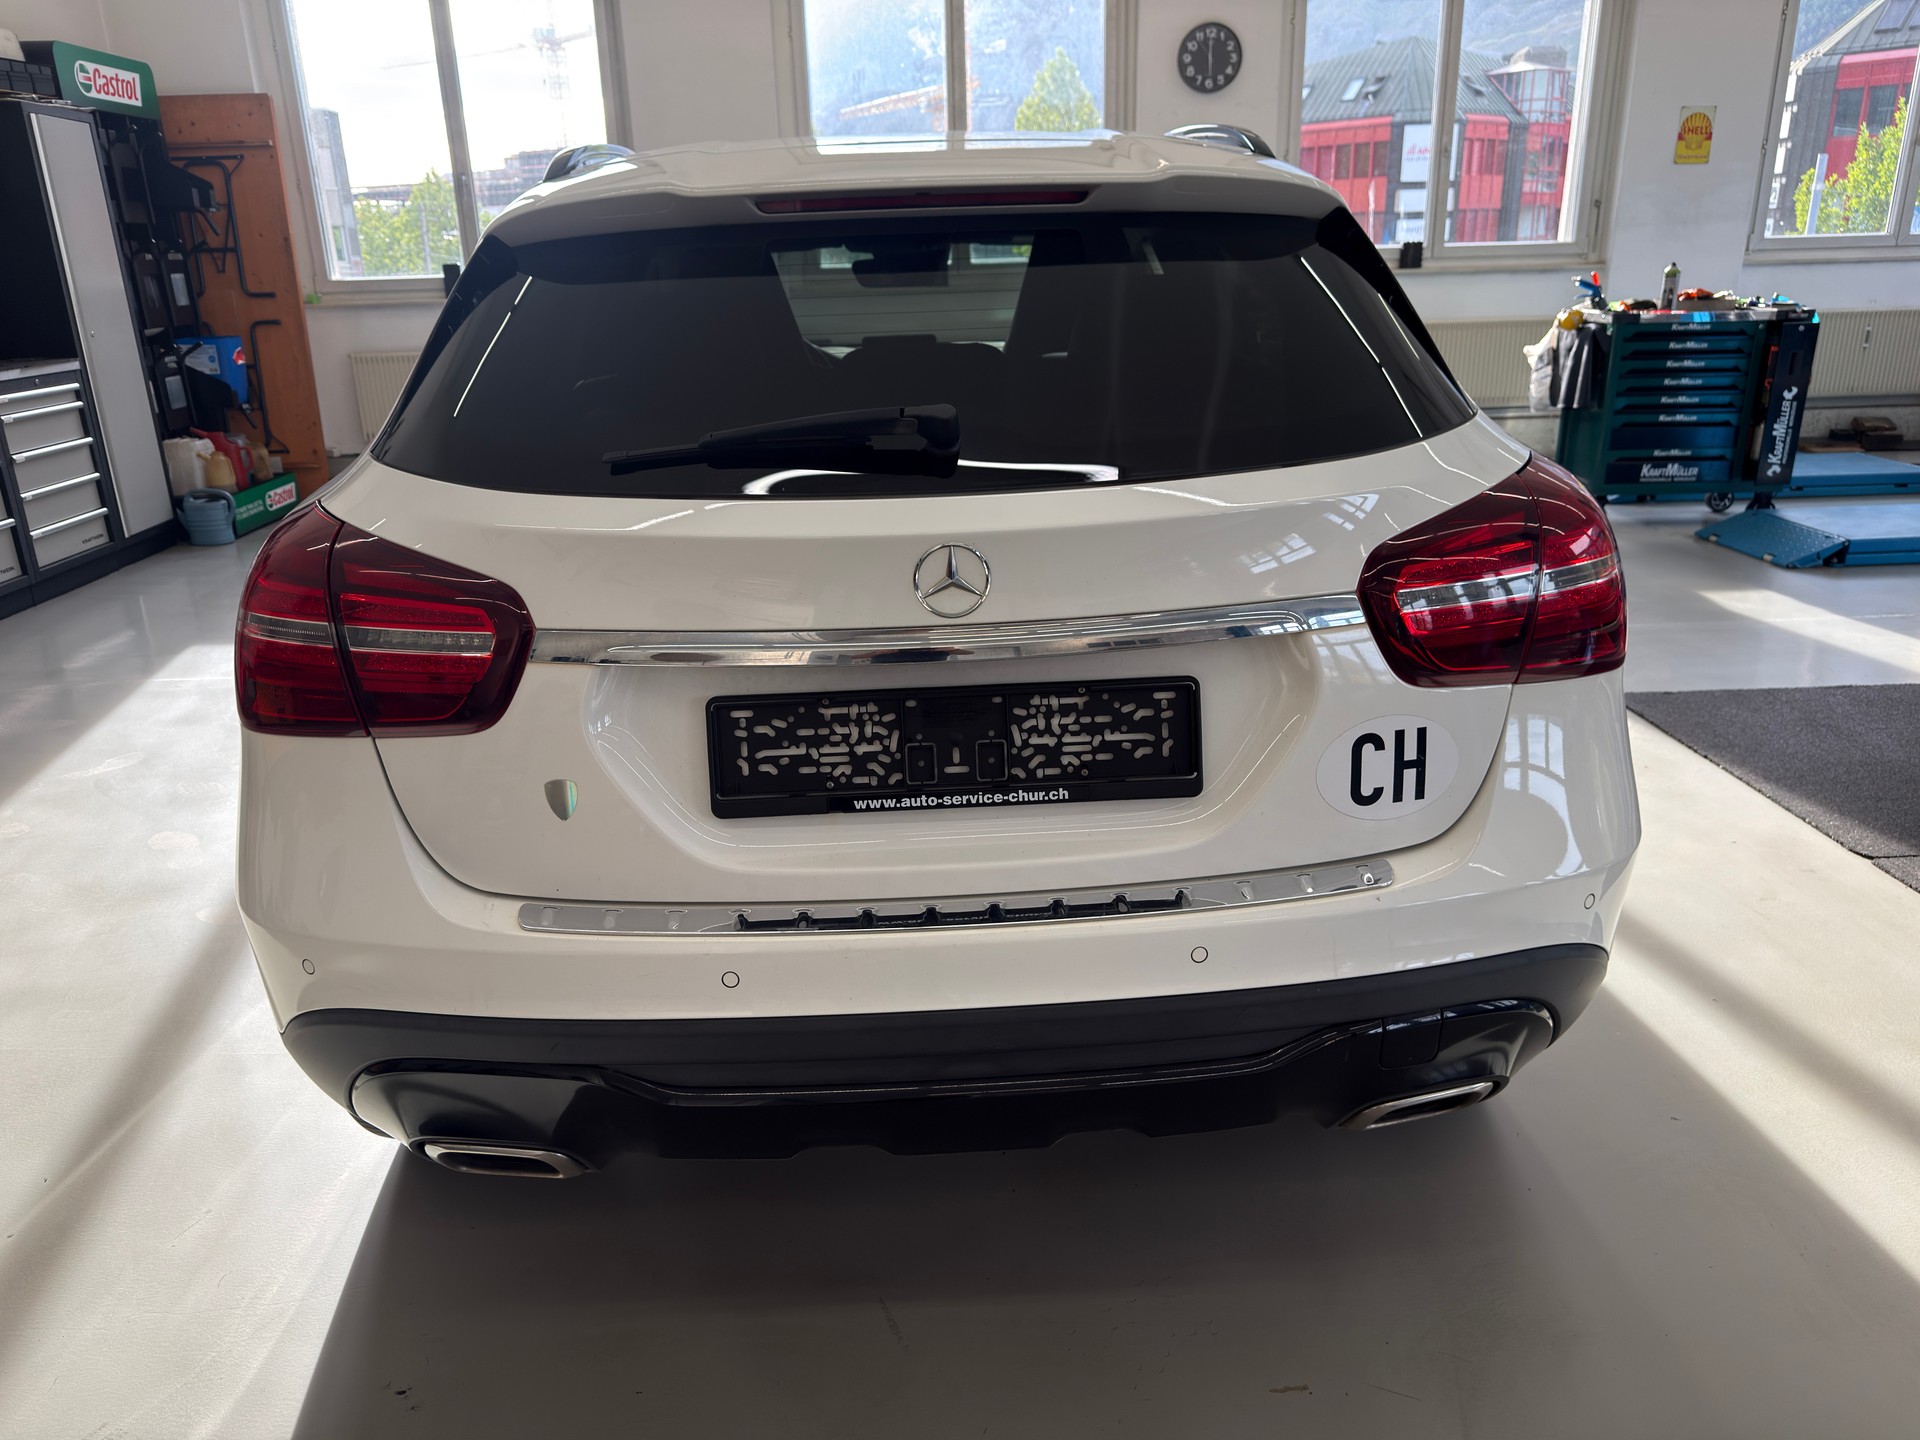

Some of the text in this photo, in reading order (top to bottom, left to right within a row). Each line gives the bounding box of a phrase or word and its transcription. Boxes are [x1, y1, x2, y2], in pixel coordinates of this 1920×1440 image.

[1196, 31, 1204, 41] 11
[1206, 27, 1217, 38] 12
[1220, 31, 1225, 41] 1
[1187, 40, 1198, 52] 10
[1226, 40, 1234, 51] 2
[1182, 53, 1192, 64] 9
[1229, 52, 1237, 63] 3
[1186, 65, 1195, 77] 8
[1225, 64, 1233, 75] 4
[92, 67, 139, 102] Castrol
[1195, 74, 1202, 86] 7
[1204, 78, 1214, 89] 6
[1216, 74, 1225, 85] 5
[1682, 125, 1710, 136] SHELL
[1350, 726, 1427, 807] CH
[853, 788, 1069, 810] www.auto-service-chur.ch
